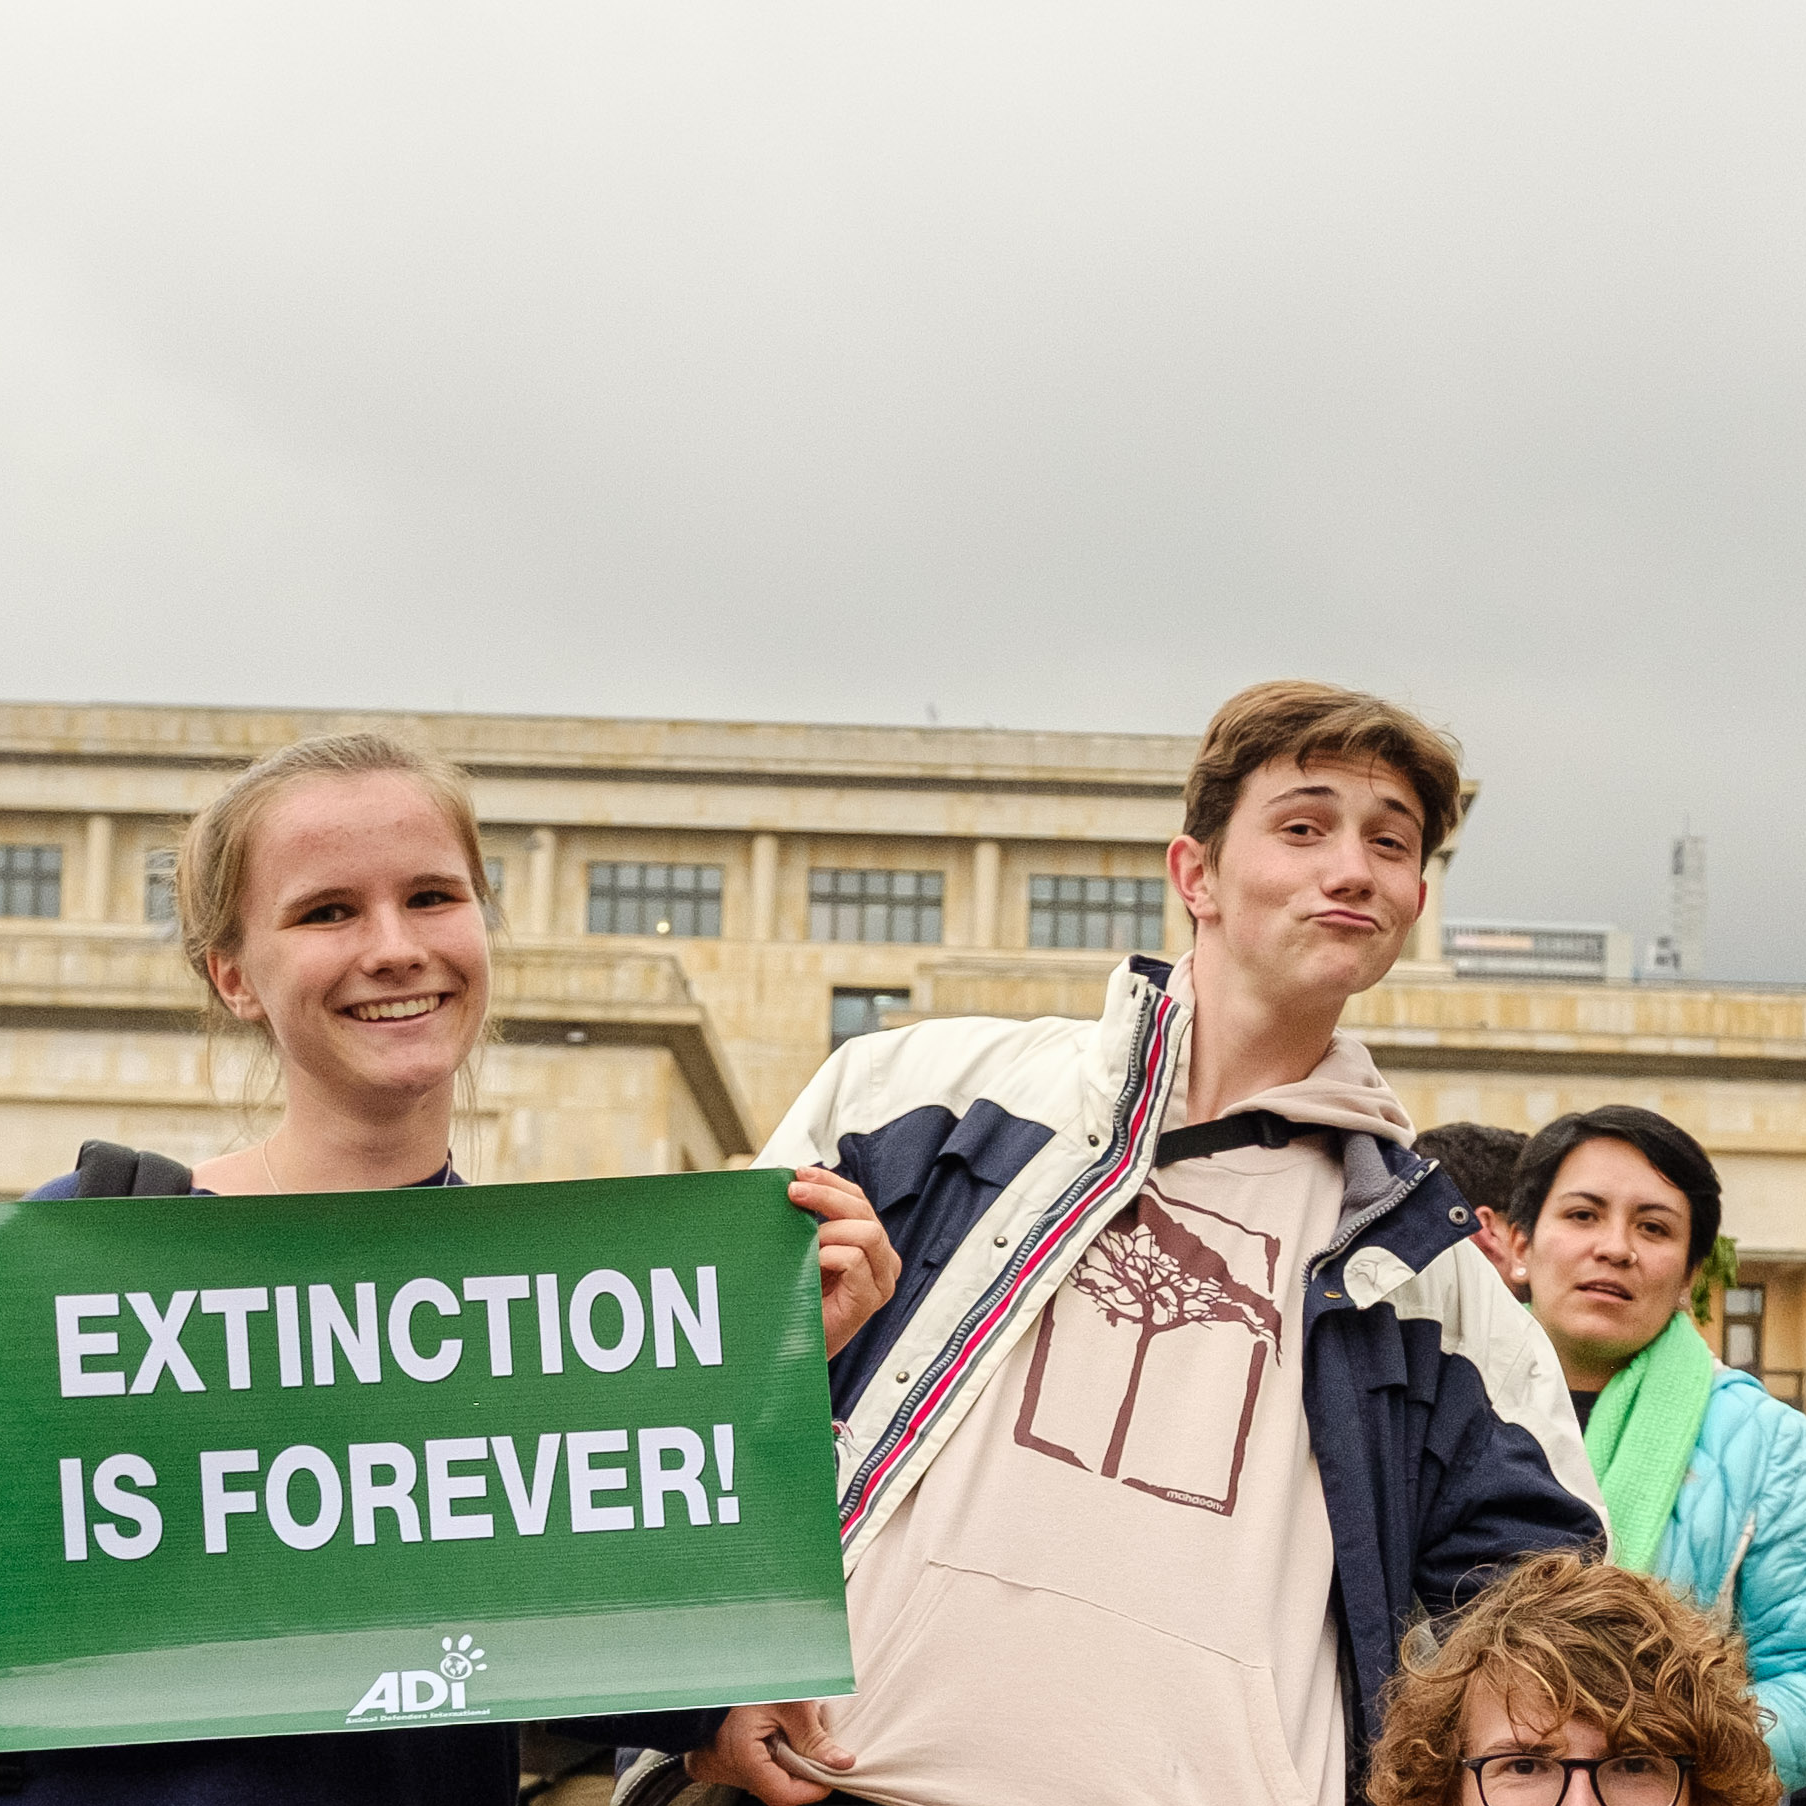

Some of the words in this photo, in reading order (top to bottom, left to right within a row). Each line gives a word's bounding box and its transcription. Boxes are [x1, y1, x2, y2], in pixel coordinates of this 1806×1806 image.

[54, 1265, 723, 1398] EXTINCTION
[59, 1453, 164, 1561] IS
[200, 1423, 740, 1554] FOREVER!
[345, 1716, 378, 1725] Animal
[380, 1713, 428, 1722] Defenders
[430, 1708, 491, 1719] International
